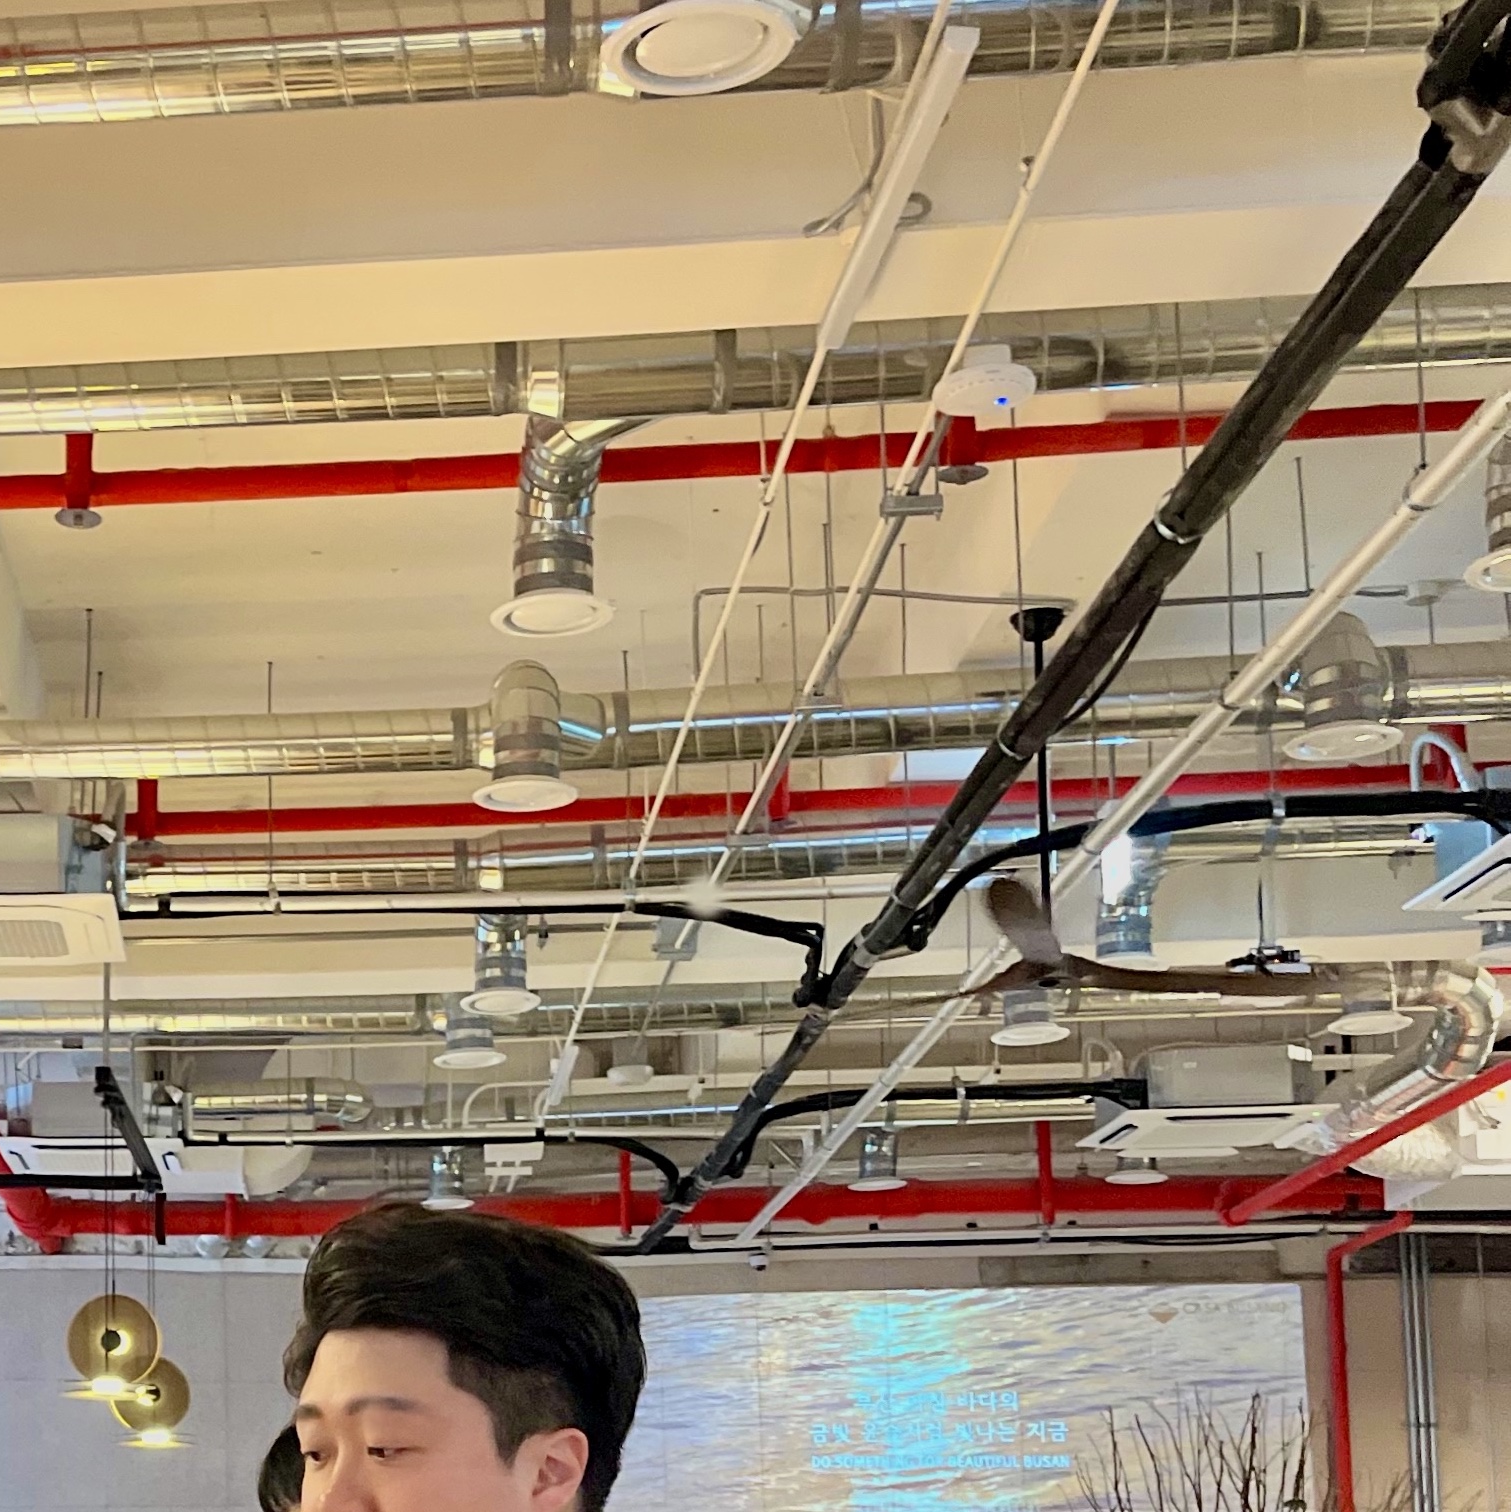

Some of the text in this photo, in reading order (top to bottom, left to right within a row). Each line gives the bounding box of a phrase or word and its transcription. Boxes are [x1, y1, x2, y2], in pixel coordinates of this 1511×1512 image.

[956, 1390, 1019, 1412] 바다의
[808, 1422, 851, 1444] 금빛
[954, 1421, 1017, 1443] 빛나는
[1025, 1420, 1070, 1443] 지금
[810, 1454, 831, 1468] DO
[1023, 1454, 1070, 1468] BUSAN
